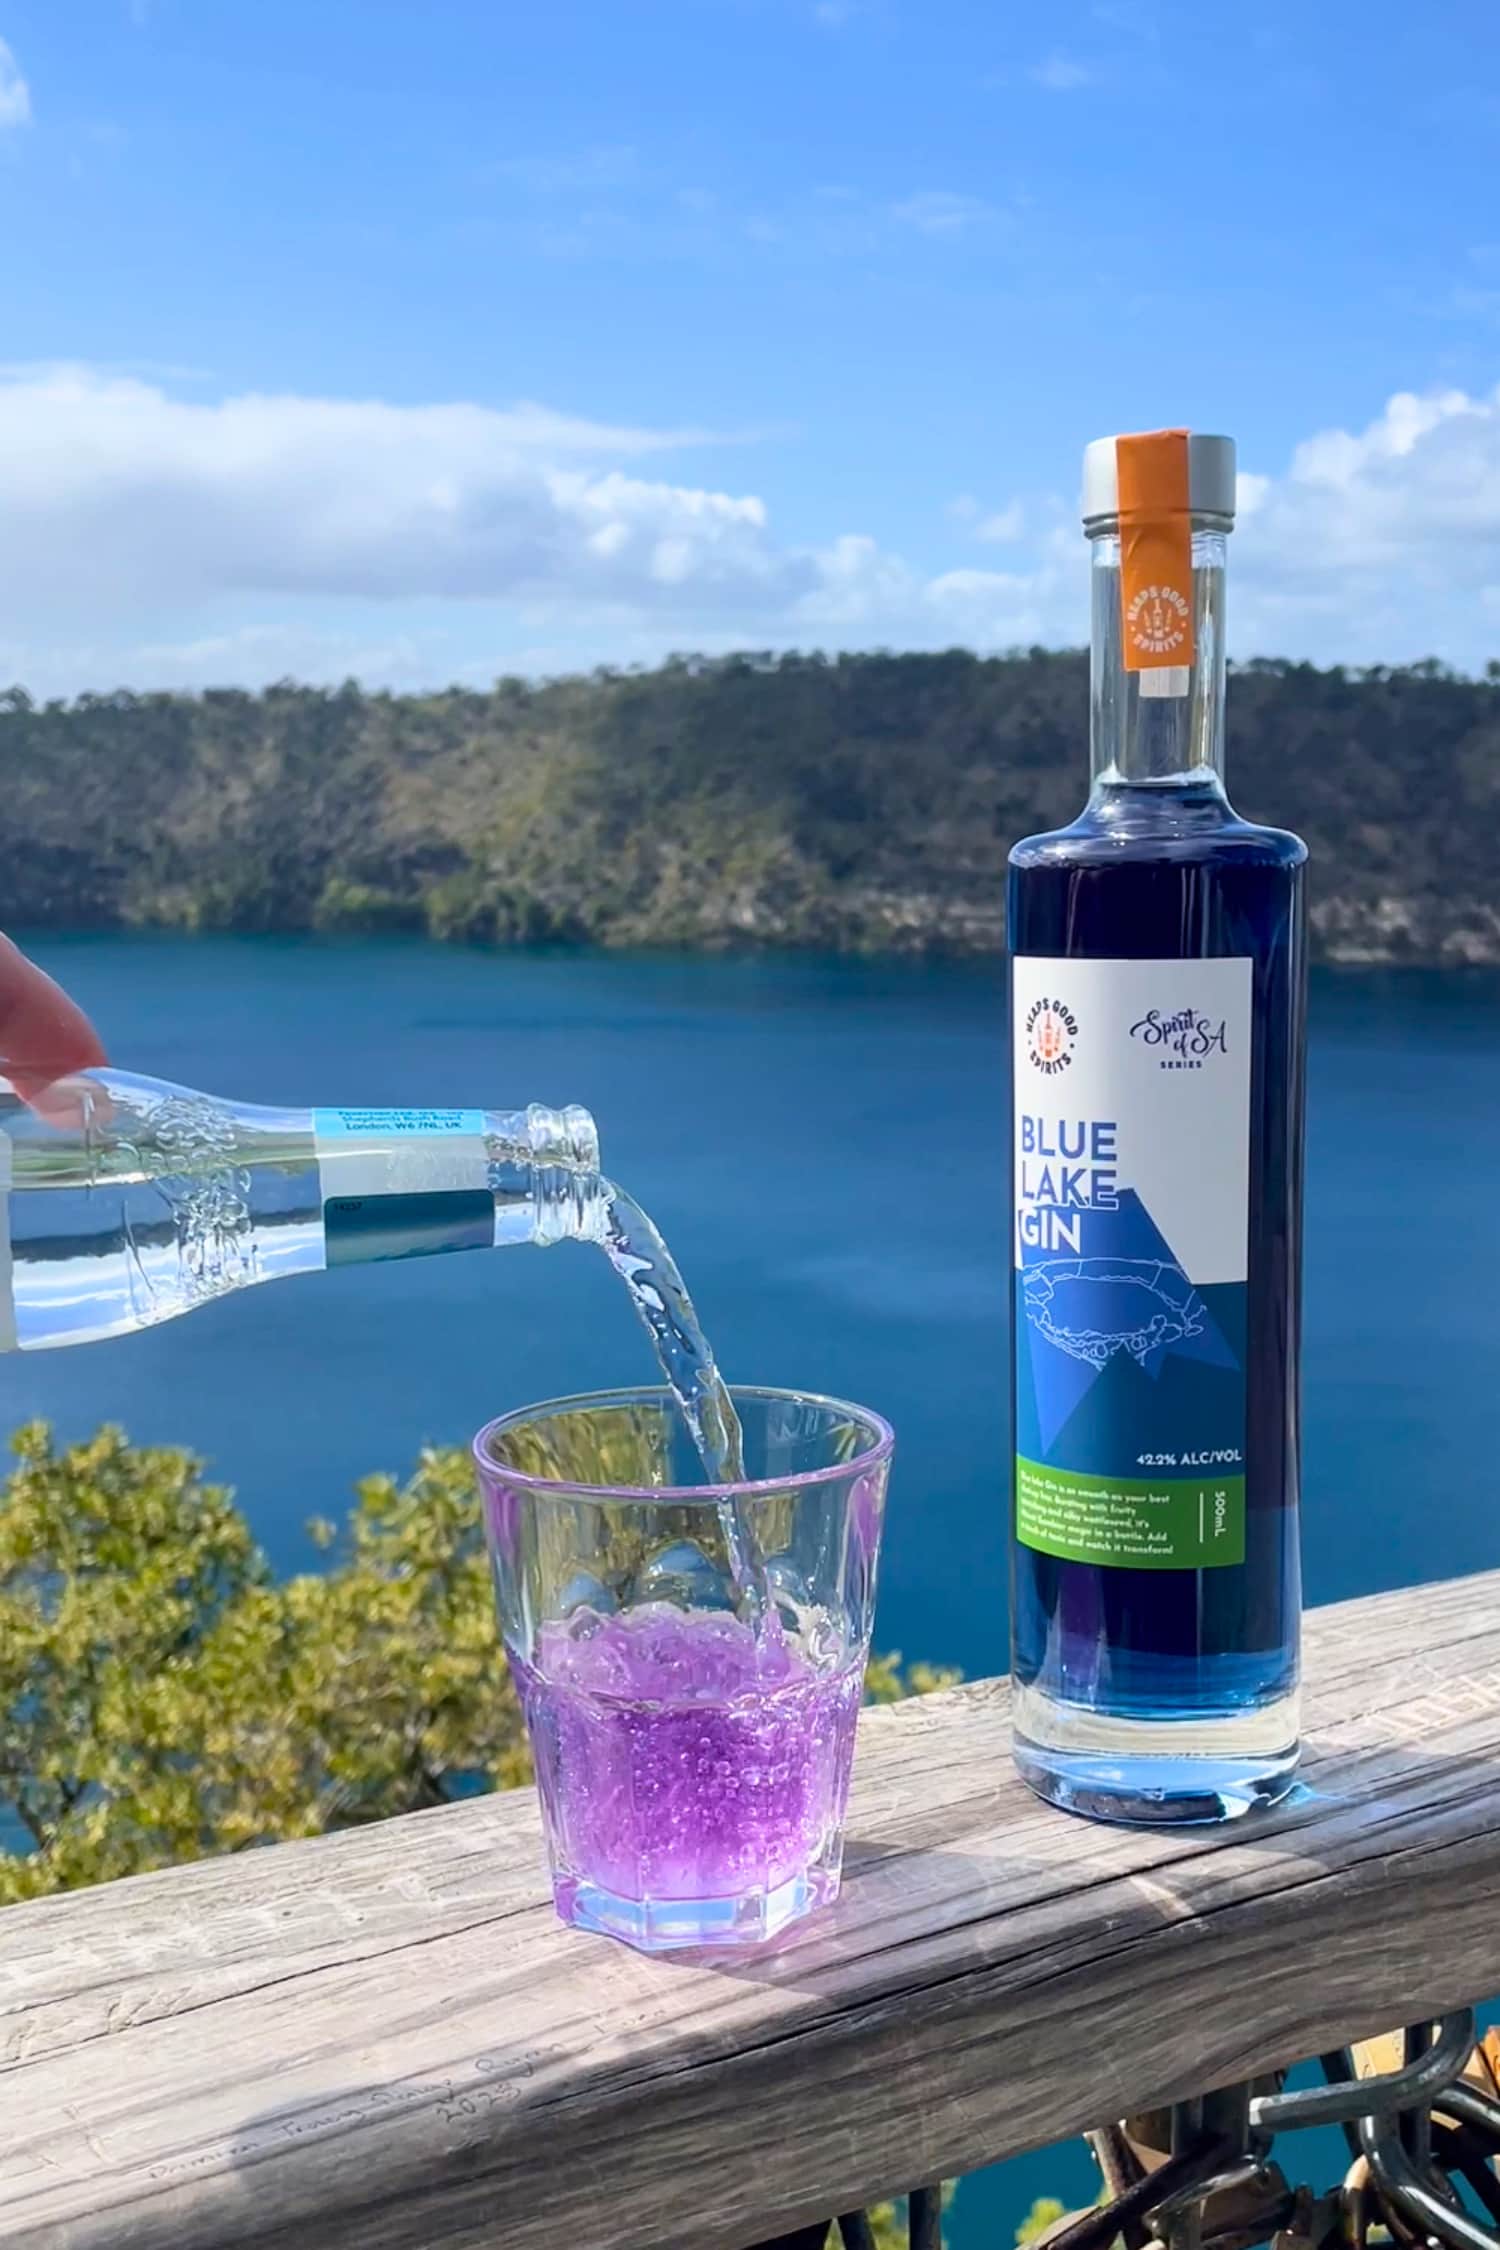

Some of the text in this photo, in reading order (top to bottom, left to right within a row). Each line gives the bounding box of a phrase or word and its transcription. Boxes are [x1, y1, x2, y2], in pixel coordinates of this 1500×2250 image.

[1127, 586, 1189, 620] HEAPS GOOD
[1133, 632, 1184, 653] SPIRITS
[1026, 997, 1079, 1036] HEAPS GOOD
[1129, 1008, 1199, 1045] Spirit
[1173, 1020, 1228, 1058] of SA
[1029, 1050, 1072, 1075] SPIRITS
[1160, 1061, 1203, 1069] SERIES
[1022, 1115, 1117, 1161] BLUE
[1022, 1160, 1118, 1209] LAKE
[1021, 1208, 1080, 1254] GIN
[1136, 1449, 1242, 1466] 42.2% ALC/VOL
[1124, 1495, 1147, 1504] your
[1148, 1493, 1170, 1503] best
[1214, 1491, 1227, 1537] 500mL
[1086, 1541, 1112, 1551] watch
[1146, 1532, 1168, 1542] Add
